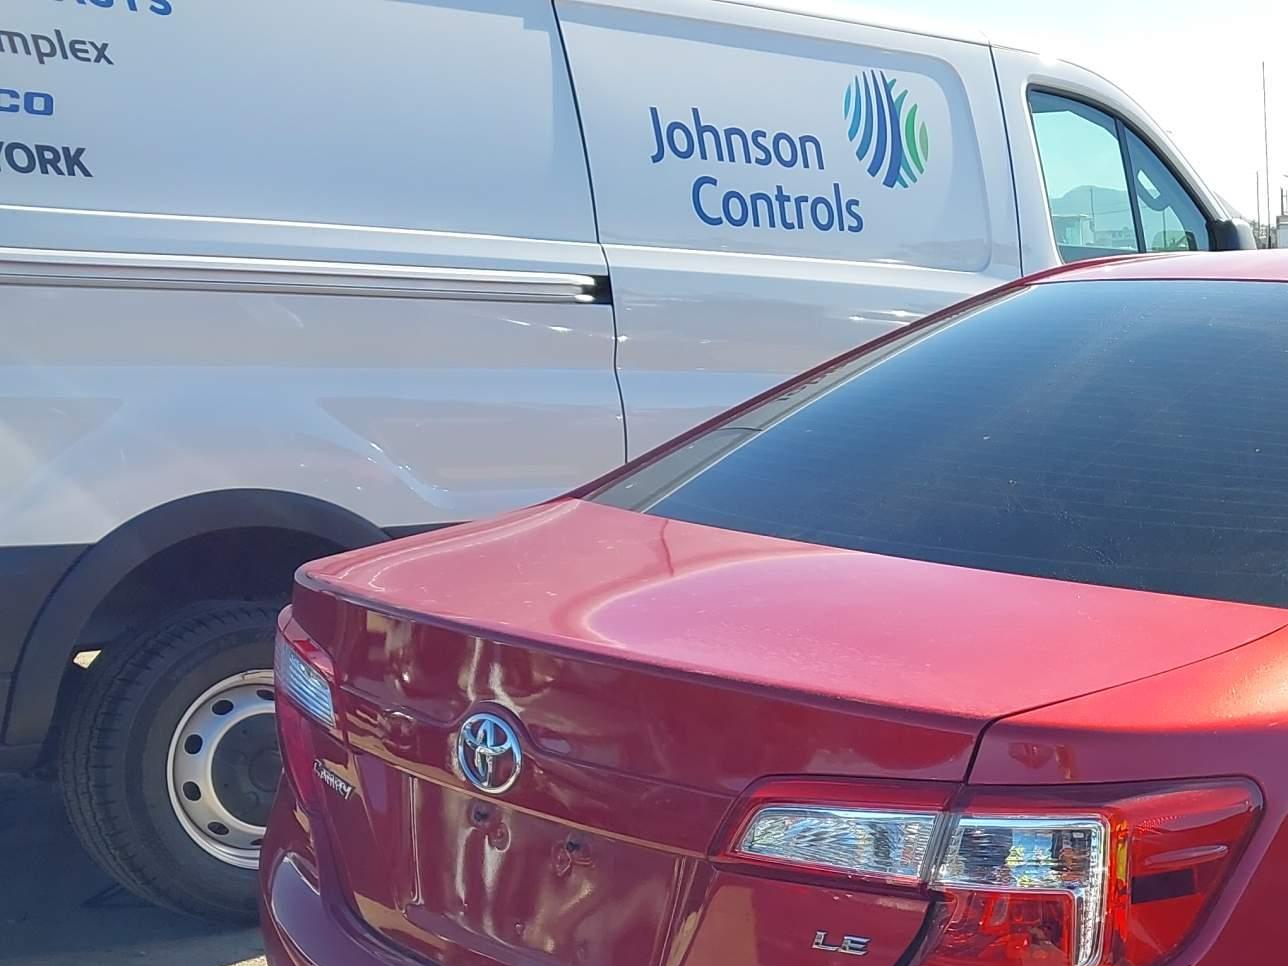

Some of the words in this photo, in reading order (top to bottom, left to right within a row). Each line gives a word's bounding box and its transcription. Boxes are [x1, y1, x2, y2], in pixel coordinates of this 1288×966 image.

[649, 106, 825, 171] Johnson
[692, 175, 864, 233] Controls
[811, 930, 871, 956] LE
